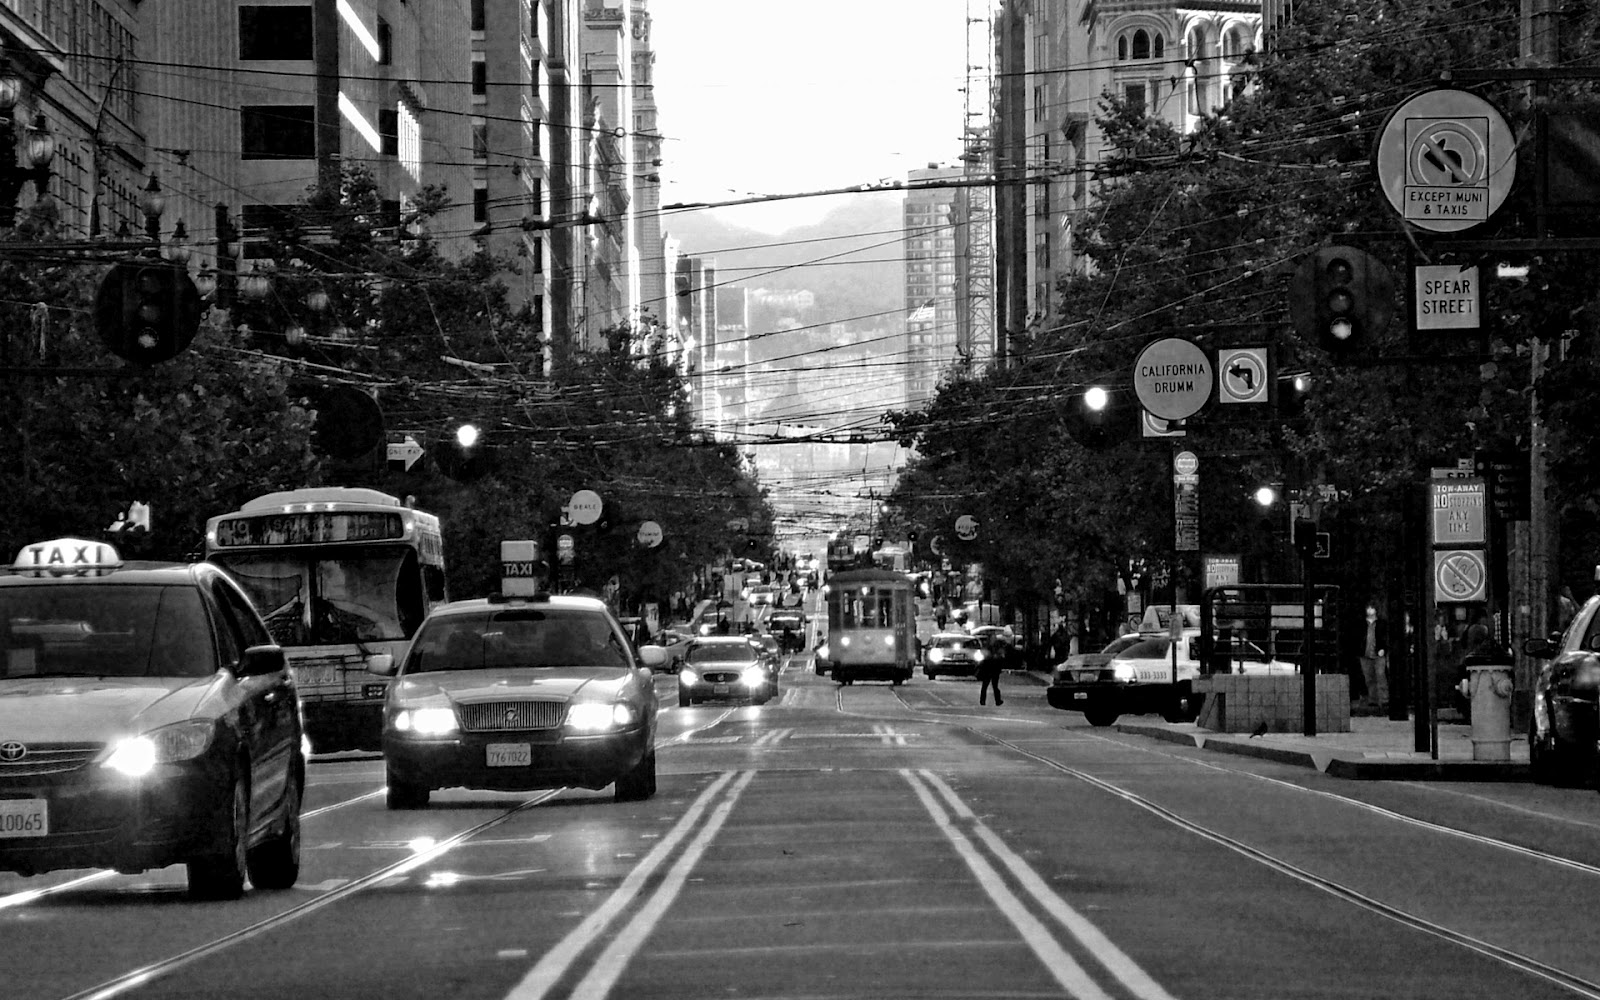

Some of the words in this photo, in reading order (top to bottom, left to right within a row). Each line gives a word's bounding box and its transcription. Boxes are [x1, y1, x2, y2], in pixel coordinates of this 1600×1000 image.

[1410, 191, 1452, 202] EXCEPT
[1456, 192, 1483, 203] MUNI
[1423, 204, 1432, 215] &
[1437, 204, 1469, 216] TAXIS
[1424, 280, 1471, 295] SPEAR
[1422, 299, 1474, 315] STREET
[1141, 363, 1206, 378] CALIFORNIA
[1154, 380, 1195, 394] DRUMM
[1436, 484, 1480, 493] TOW-AWAY
[1433, 493, 1448, 508] NO
[1448, 510, 1469, 521] ANY
[1448, 522, 1470, 533] TIME
[28, 545, 103, 565] TAXI
[503, 563, 533, 576] TAXI
